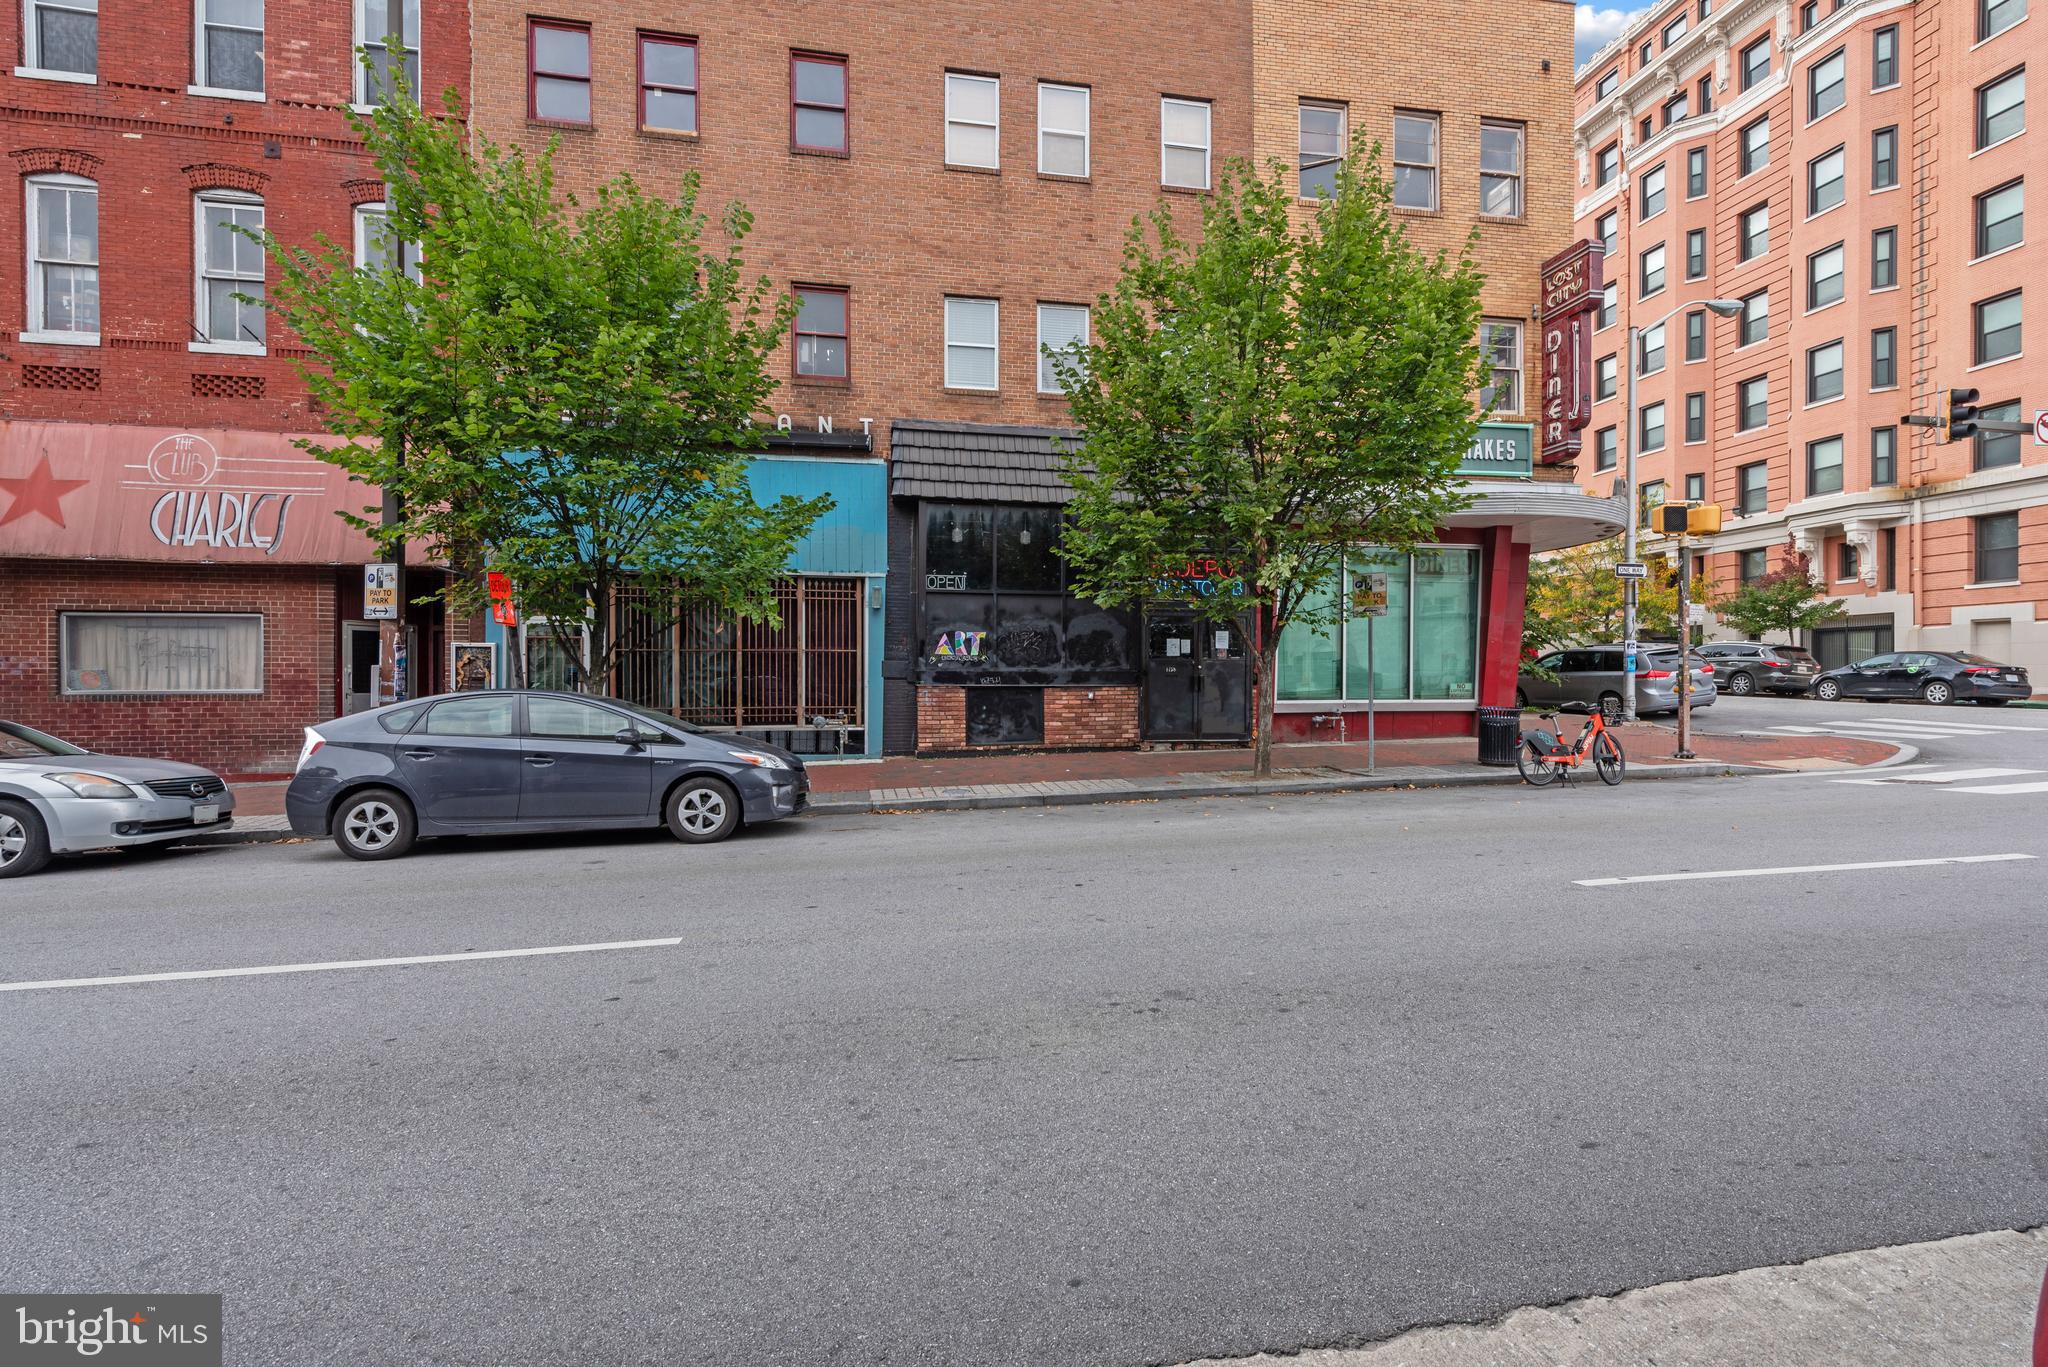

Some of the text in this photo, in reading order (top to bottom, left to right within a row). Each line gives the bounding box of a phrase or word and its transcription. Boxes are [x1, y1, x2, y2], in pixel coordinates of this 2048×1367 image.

[1546, 260, 1582, 291] LOST
[1547, 277, 1583, 307] CITY
[175, 437, 194, 450] THE
[154, 452, 208, 481] CLUB
[150, 491, 295, 555] CHARLES
[369, 589, 392, 597] PAY TO
[927, 576, 964, 589] OPEN
[371, 597, 389, 605] PARK
[934, 630, 987, 656] ART
